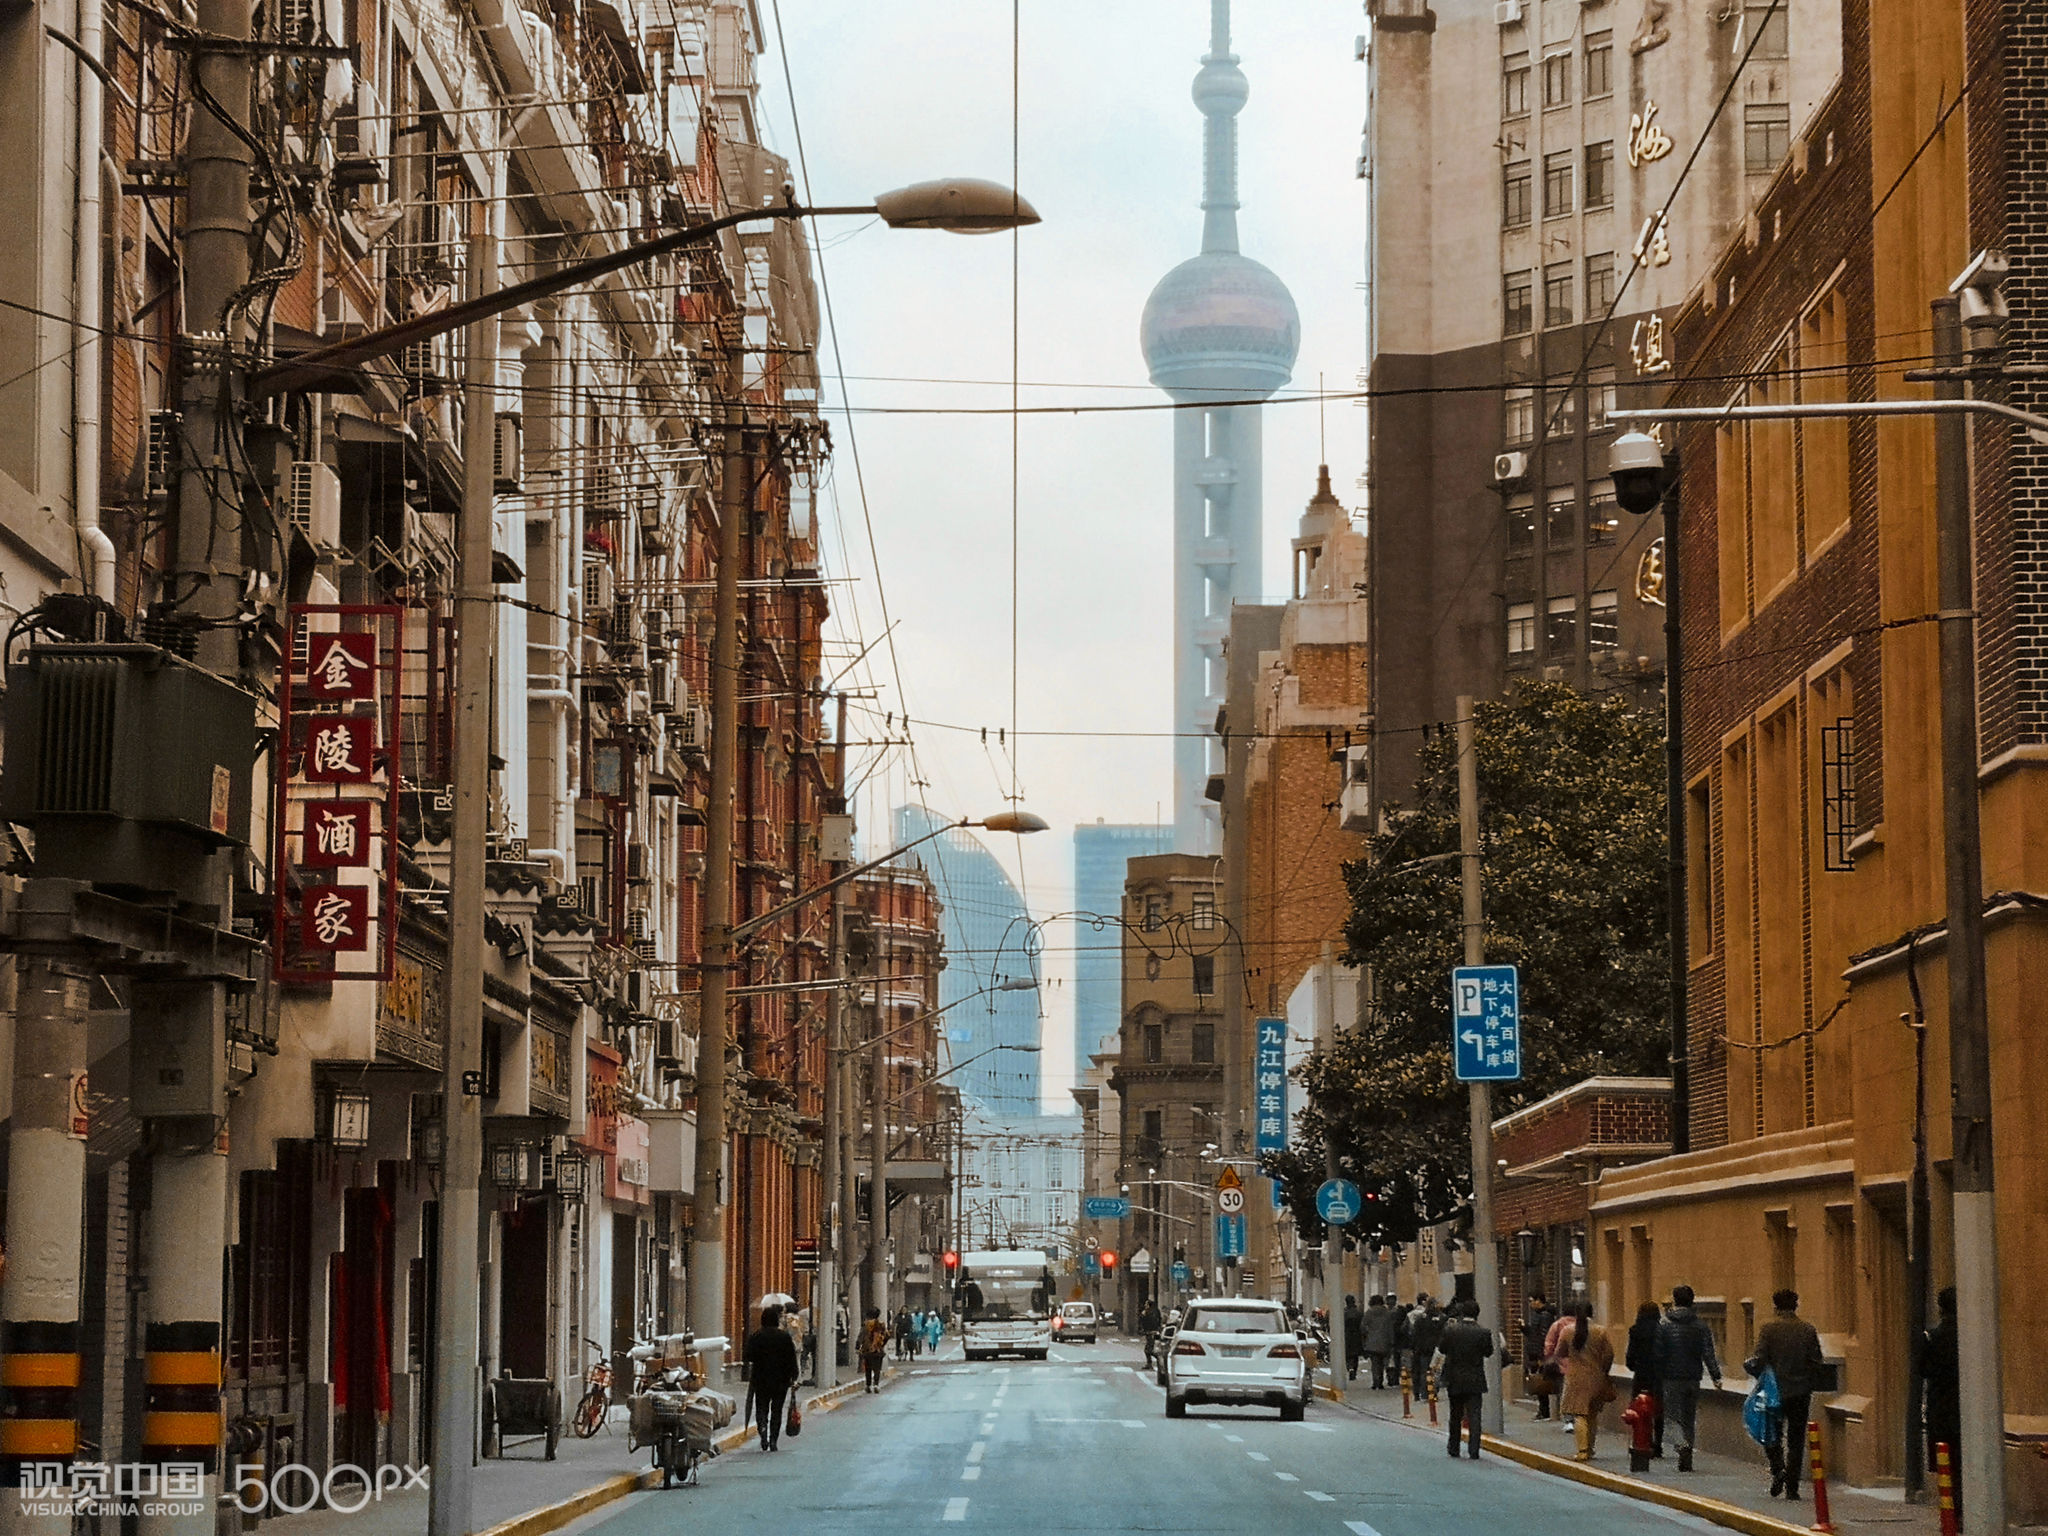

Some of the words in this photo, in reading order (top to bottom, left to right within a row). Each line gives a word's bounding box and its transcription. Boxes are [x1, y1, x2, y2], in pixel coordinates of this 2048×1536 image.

[312, 639, 369, 944] 金陵酒家
[1461, 985, 1477, 1012] P
[1483, 978, 1501, 1068] 地下停车库
[1499, 981, 1516, 1064] 大丸百货
[1260, 1026, 1282, 1137] 九江停车库
[1223, 1193, 1240, 1206] 30
